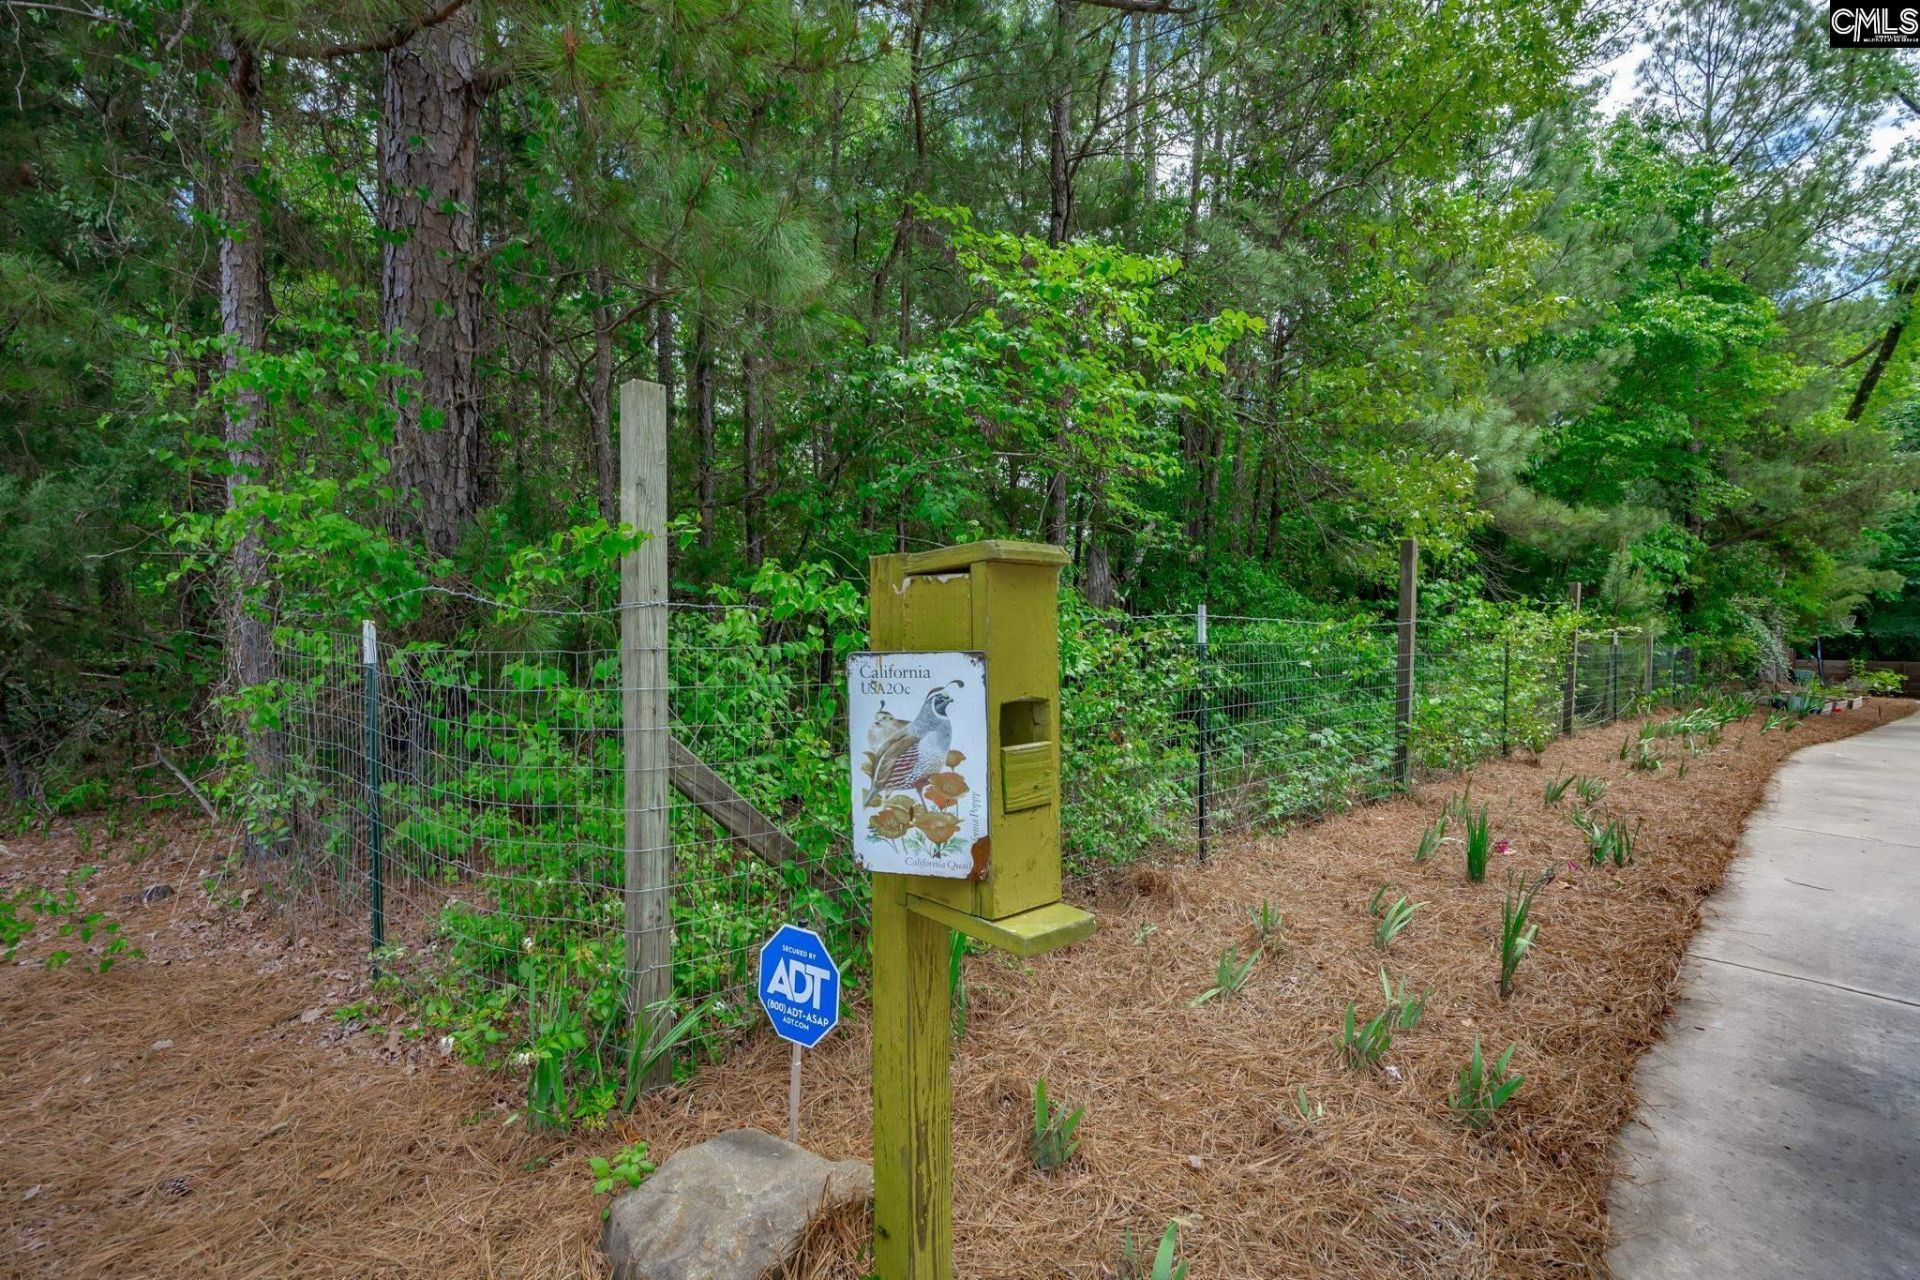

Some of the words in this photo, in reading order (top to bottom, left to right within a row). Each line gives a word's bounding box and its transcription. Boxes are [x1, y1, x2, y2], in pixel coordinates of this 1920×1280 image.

[859, 664, 931, 679] California
[904, 856, 946, 869] California
[782, 944, 808, 957] SECURED
[808, 951, 816, 959] BY
[766, 957, 831, 1009] ADT
[767, 999, 786, 1014] (800)
[787, 1007, 829, 1027] ADT-ASAP
[783, 1017, 809, 1031] ADT.COM
